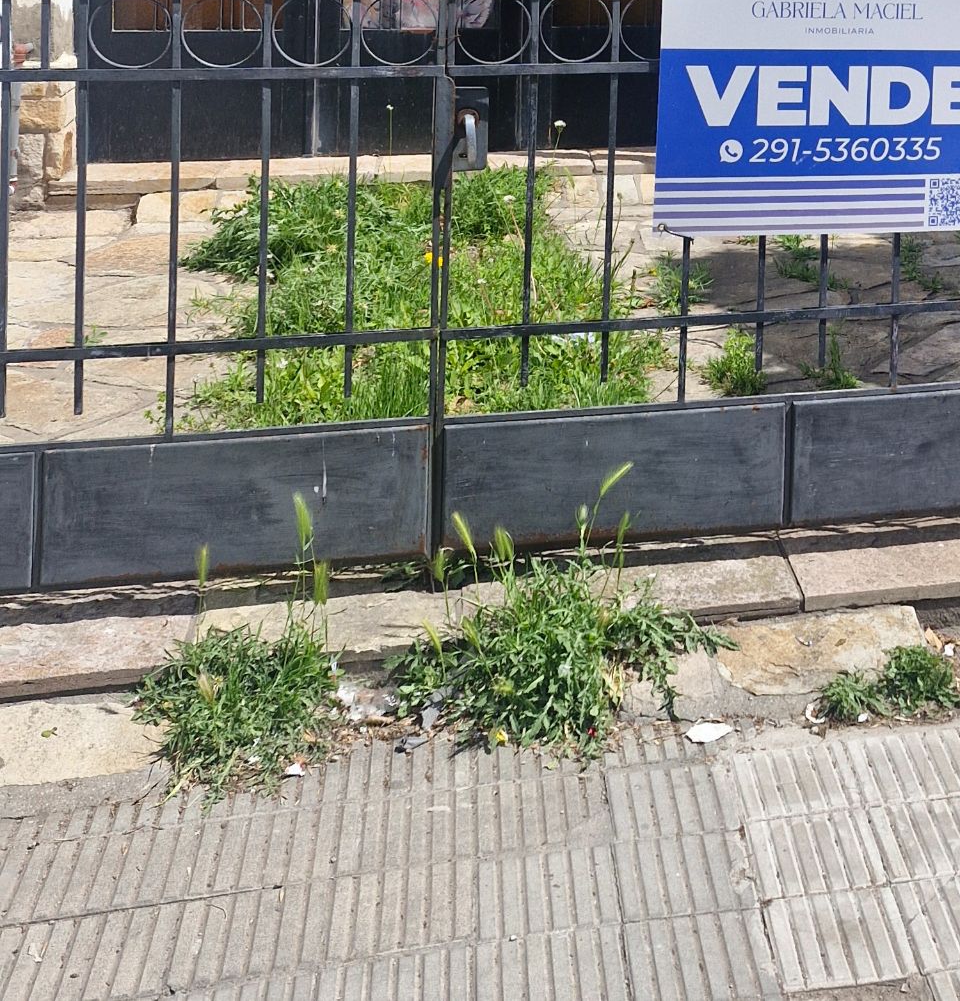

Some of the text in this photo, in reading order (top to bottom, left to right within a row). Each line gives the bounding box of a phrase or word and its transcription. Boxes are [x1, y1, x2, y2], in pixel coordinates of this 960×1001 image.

[751, 0, 924, 20] GABRIELA MACIEL
[804, 26, 875, 35] INMOBILIARIA
[749, 136, 942, 163] 291-5360335
